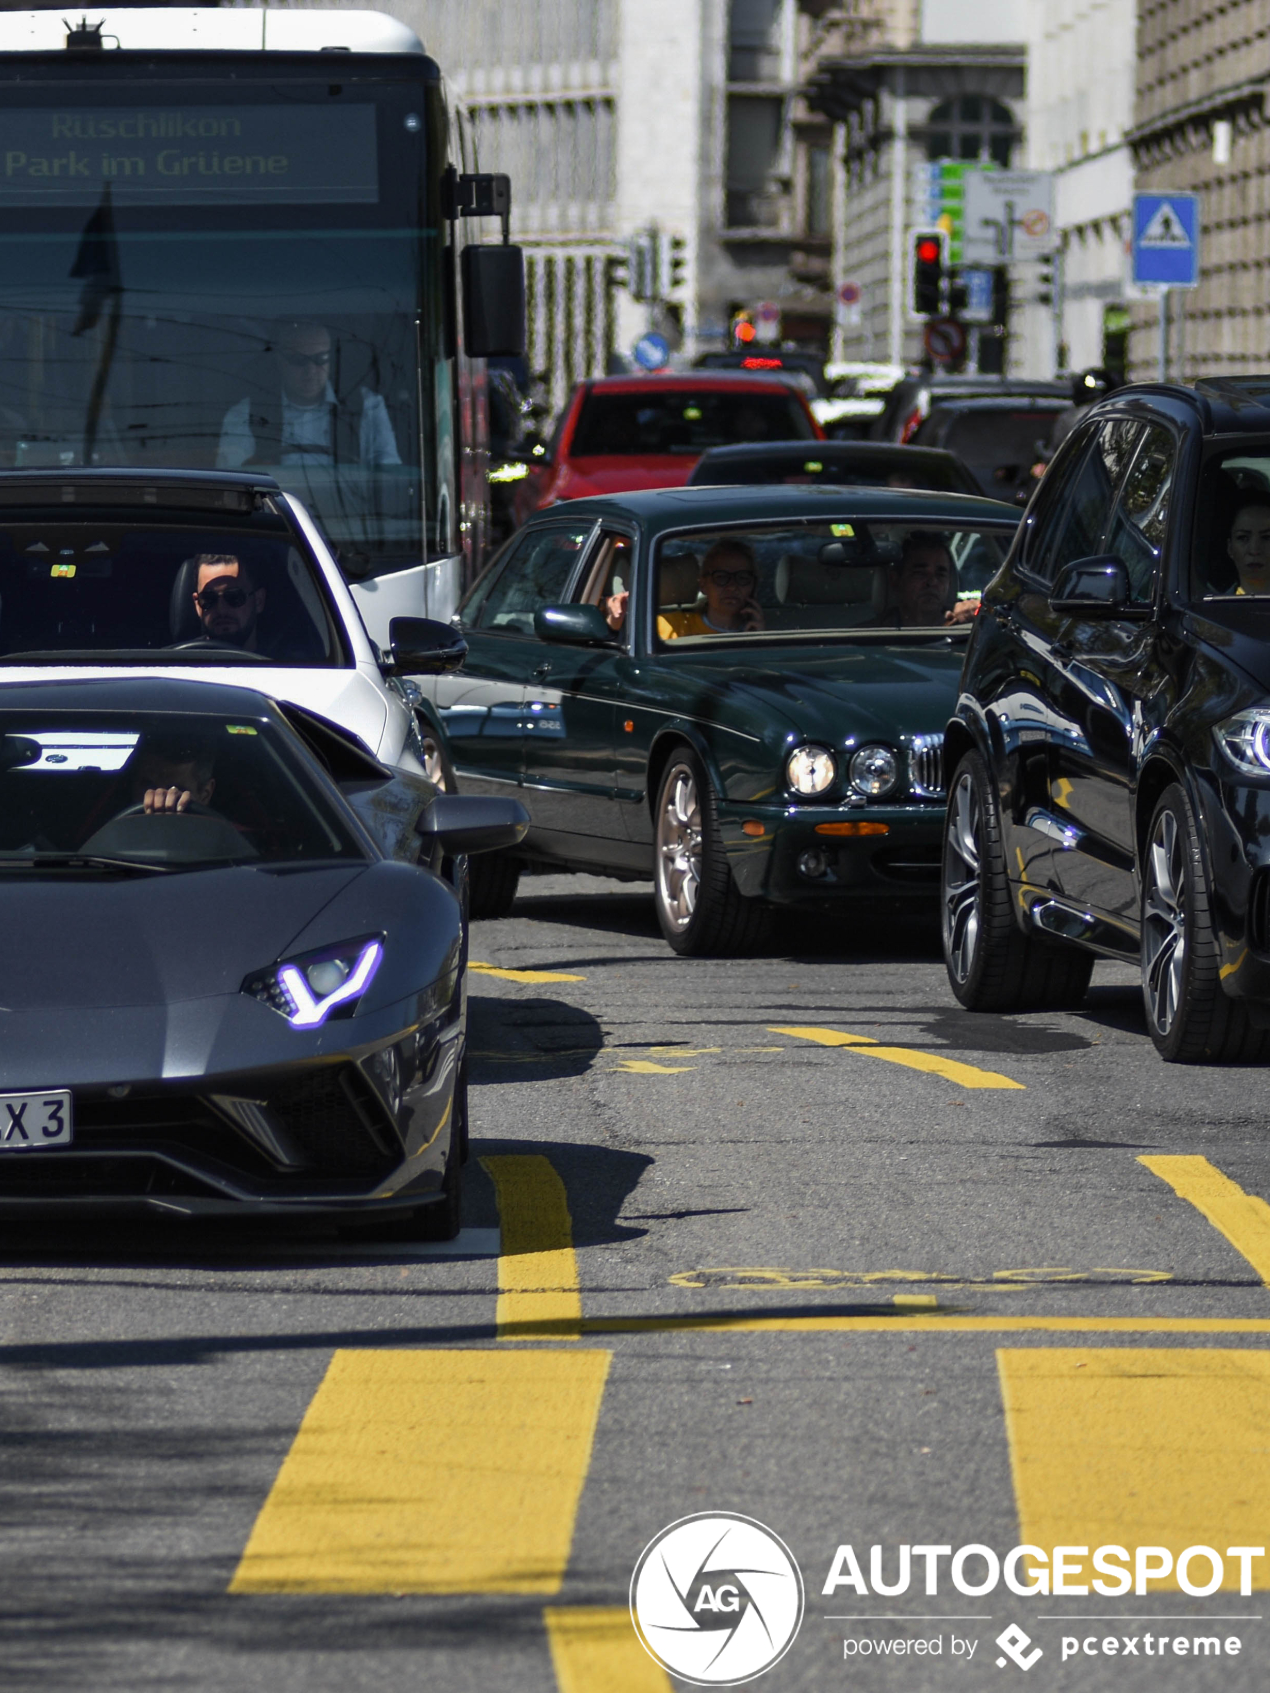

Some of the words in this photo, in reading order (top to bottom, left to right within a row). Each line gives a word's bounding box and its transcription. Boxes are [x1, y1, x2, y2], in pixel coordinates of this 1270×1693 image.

[52, 111, 241, 139] Rüschlikon
[6, 150, 89, 176] Park
[102, 152, 145, 176] im
[157, 149, 289, 176] Grüene
[41, 1099, 64, 1138] 3
